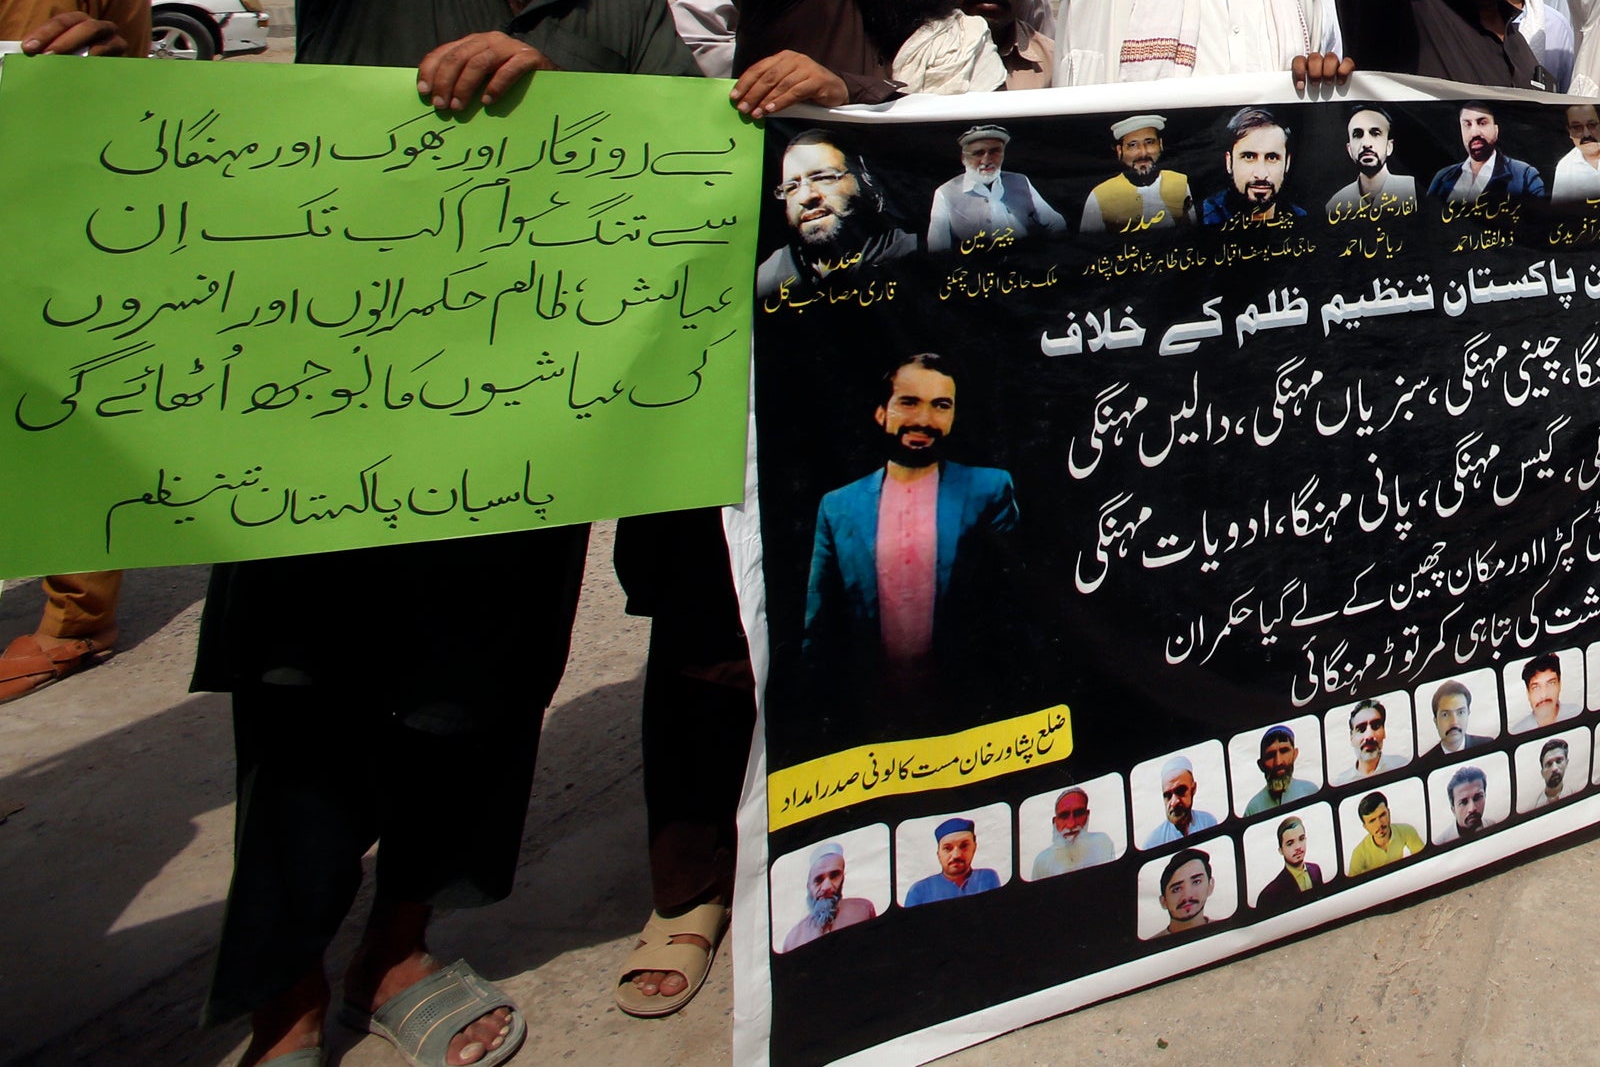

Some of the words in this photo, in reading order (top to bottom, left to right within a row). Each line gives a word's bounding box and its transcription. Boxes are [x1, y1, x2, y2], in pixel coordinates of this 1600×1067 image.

[251, 136, 322, 169] اور
[437, 135, 507, 171] اور
[201, 187, 339, 243] تک
[647, 213, 738, 247] سے
[1120, 209, 1166, 233] صدر
[217, 288, 298, 335] اور
[1321, 274, 1435, 336] تنظیم
[1443, 257, 1577, 316] پاکستان
[1041, 305, 1147, 357] خلاف
[1159, 296, 1223, 356] کے
[1236, 287, 1309, 349] ظلم
[1504, 335, 1561, 407] چینی
[1068, 381, 1148, 479] مہنگی
[1138, 370, 1229, 467] دالیں
[1493, 414, 1571, 506] گیس
[231, 455, 401, 528] پاکستان
[408, 460, 555, 523] پاسبان
[1358, 452, 1412, 540] پانی
[1075, 491, 1152, 594] مہنگی
[1447, 540, 1506, 596] مکان
[1291, 583, 1339, 627] لے
[1342, 562, 1385, 616] کے
[1389, 541, 1447, 611] چھین
[1165, 586, 1255, 666] حکمران
[1260, 577, 1300, 645] گیا
[1408, 602, 1465, 682] کمر
[1454, 613, 1512, 664] تباہی
[1515, 578, 1551, 648] کی
[1291, 635, 1376, 708] مہنگائی
